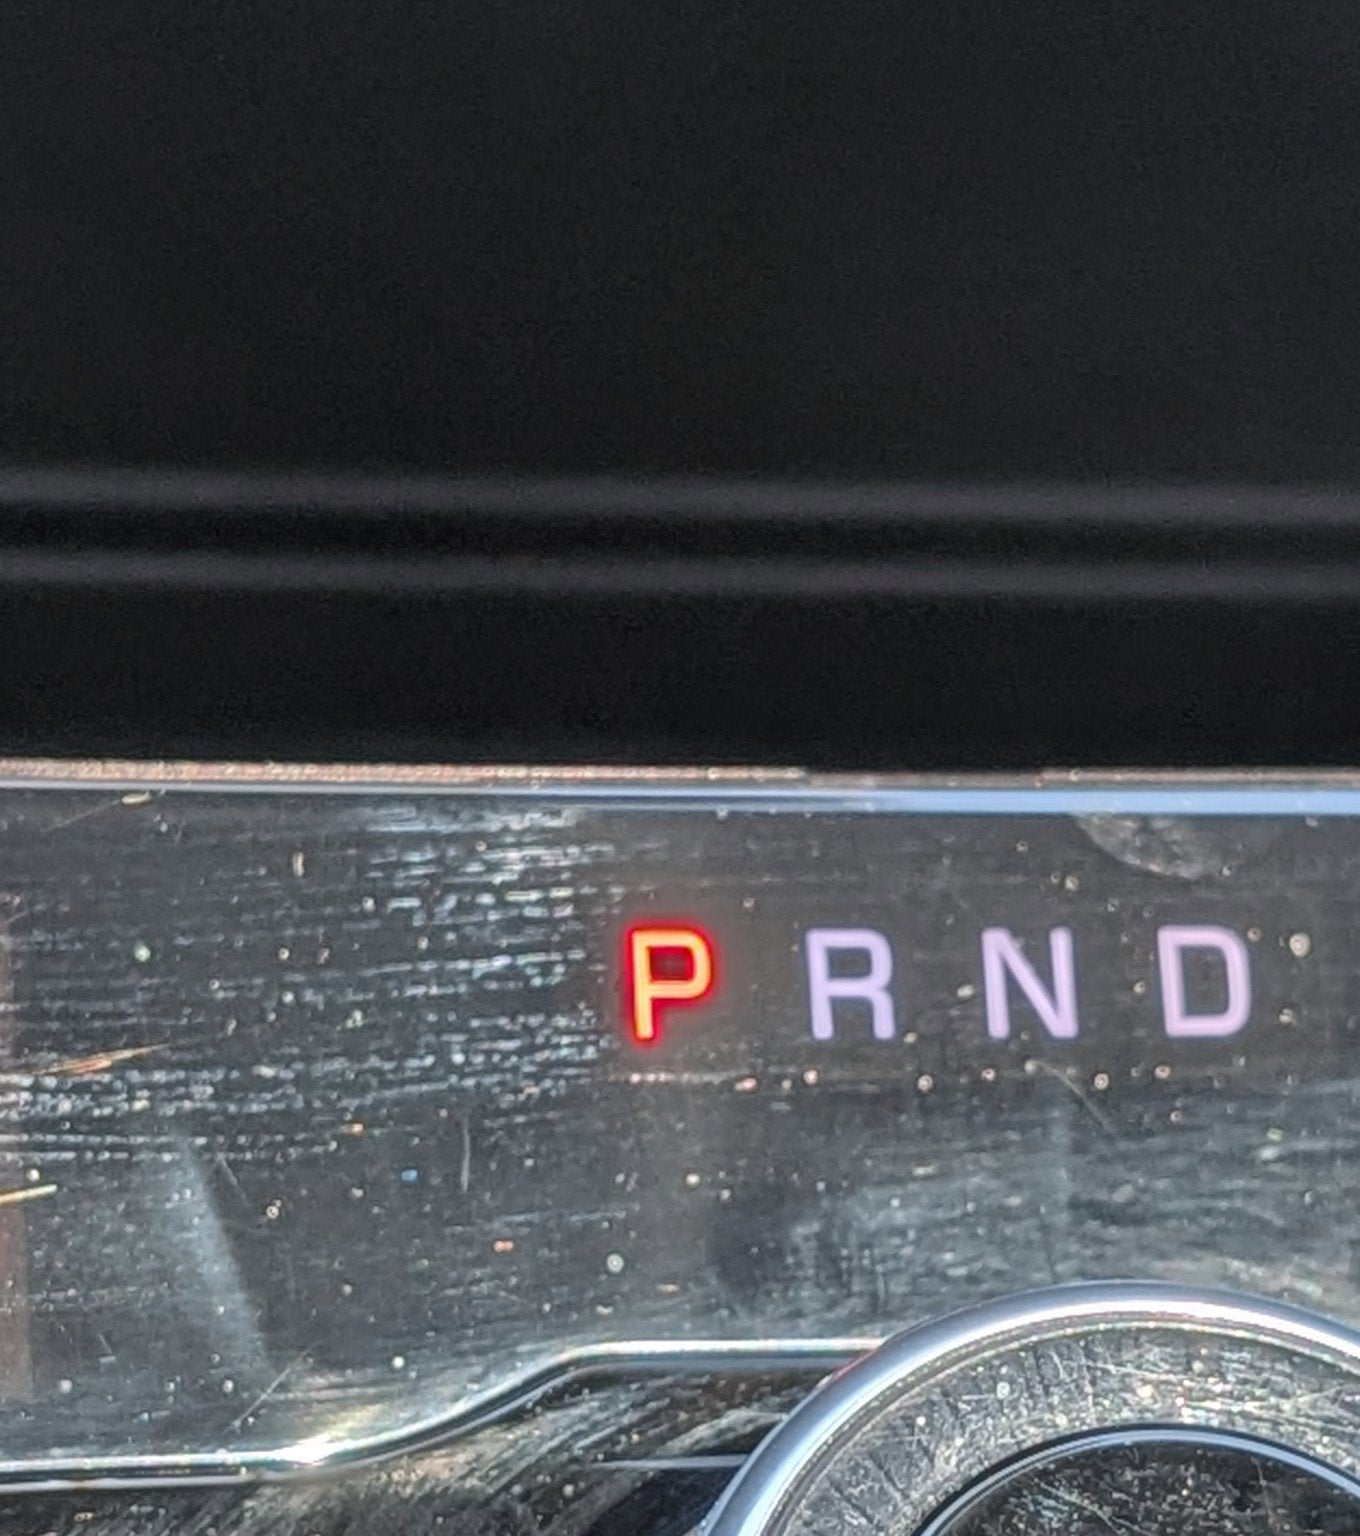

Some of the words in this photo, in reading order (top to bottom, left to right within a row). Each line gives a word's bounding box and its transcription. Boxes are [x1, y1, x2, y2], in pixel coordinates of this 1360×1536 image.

[624, 920, 716, 1045] P
[804, 926, 898, 1042] R
[979, 924, 1080, 1041] N
[1155, 924, 1253, 1039] D
